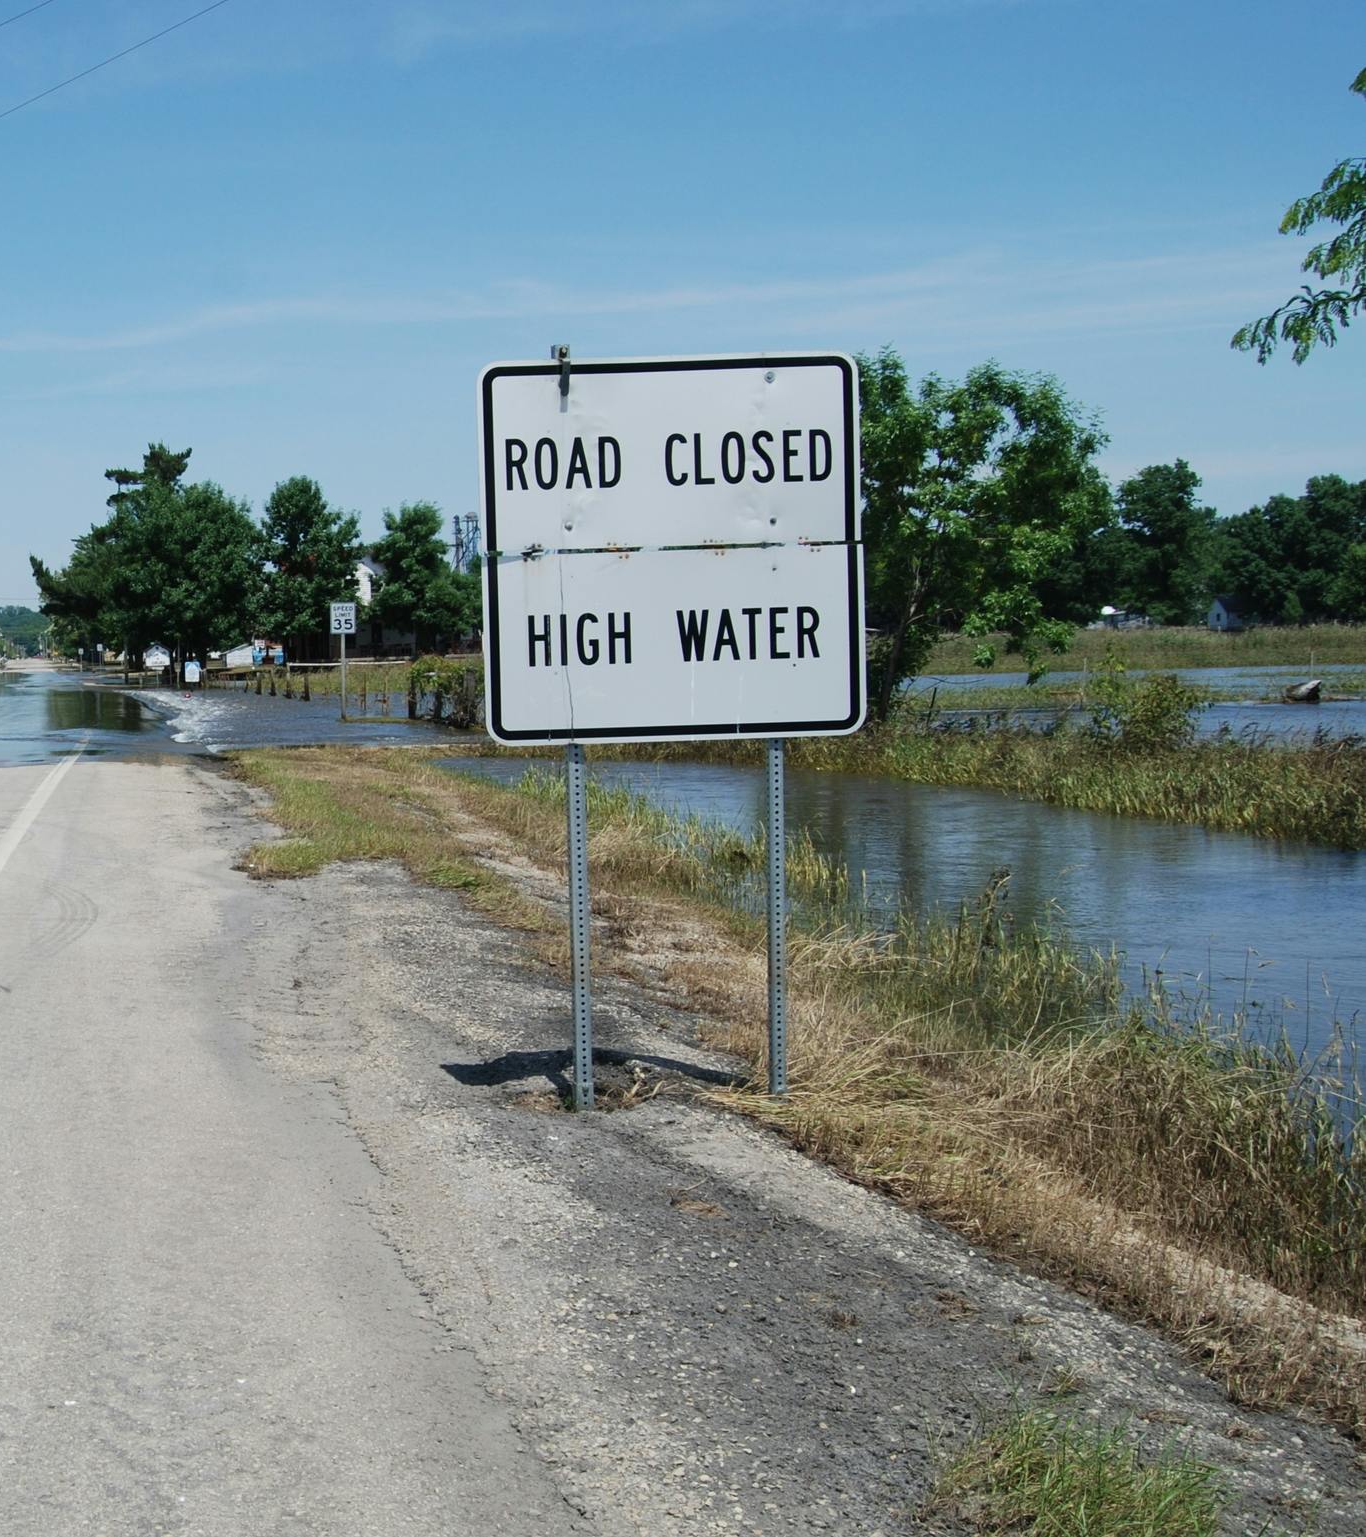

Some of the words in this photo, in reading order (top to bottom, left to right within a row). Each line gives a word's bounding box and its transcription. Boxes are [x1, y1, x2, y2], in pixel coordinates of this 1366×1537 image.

[505, 436, 622, 491] ROAD
[664, 429, 833, 487] CLOSED
[333, 618, 353, 630] 35
[528, 611, 632, 667] HIGH
[676, 606, 821, 662] WATER
